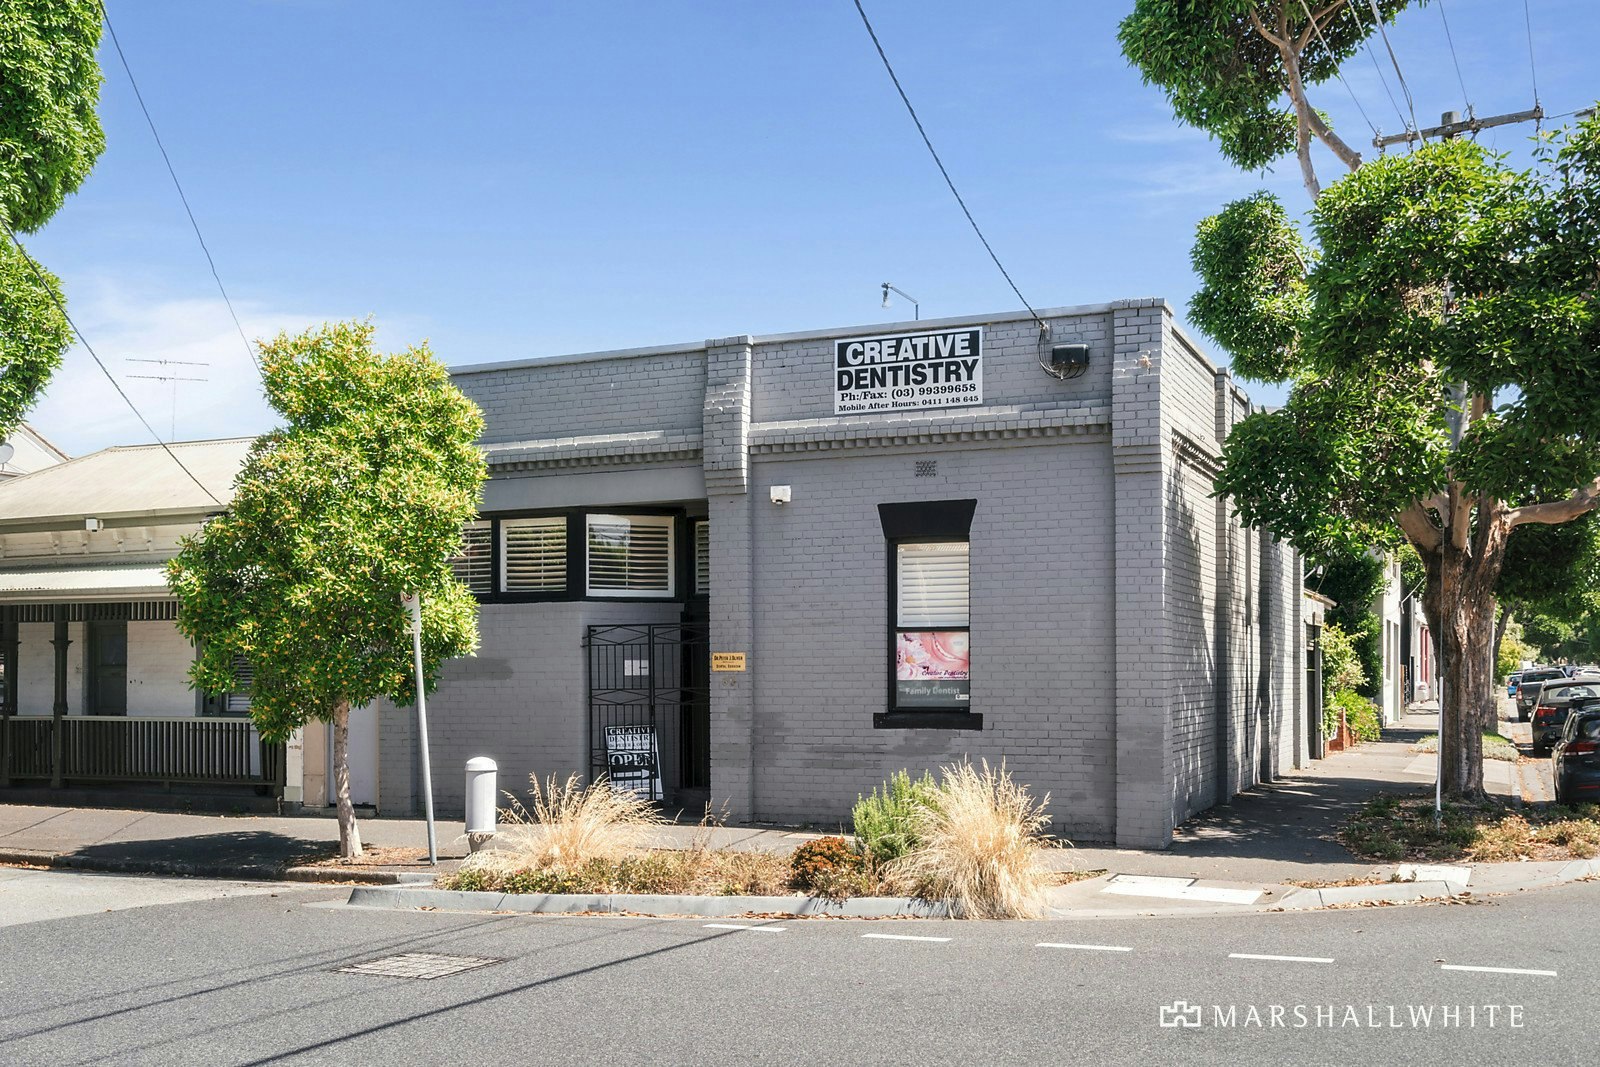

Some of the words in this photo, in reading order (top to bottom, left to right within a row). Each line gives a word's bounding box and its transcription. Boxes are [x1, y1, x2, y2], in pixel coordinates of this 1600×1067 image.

[845, 333, 971, 366] CREATIVE
[837, 358, 980, 391] DENTISTRY
[840, 390, 888, 402] Ph:/Fax:
[891, 387, 915, 400] (03)
[918, 383, 977, 396] 99399658
[838, 404, 866, 412] Mobile
[867, 402, 890, 410] After
[891, 400, 920, 408] Hours:
[921, 398, 942, 406] 0411
[945, 396, 961, 404] 148
[963, 395, 979, 403] 645
[905, 686, 931, 696] Family
[932, 686, 960, 695] Dentist
